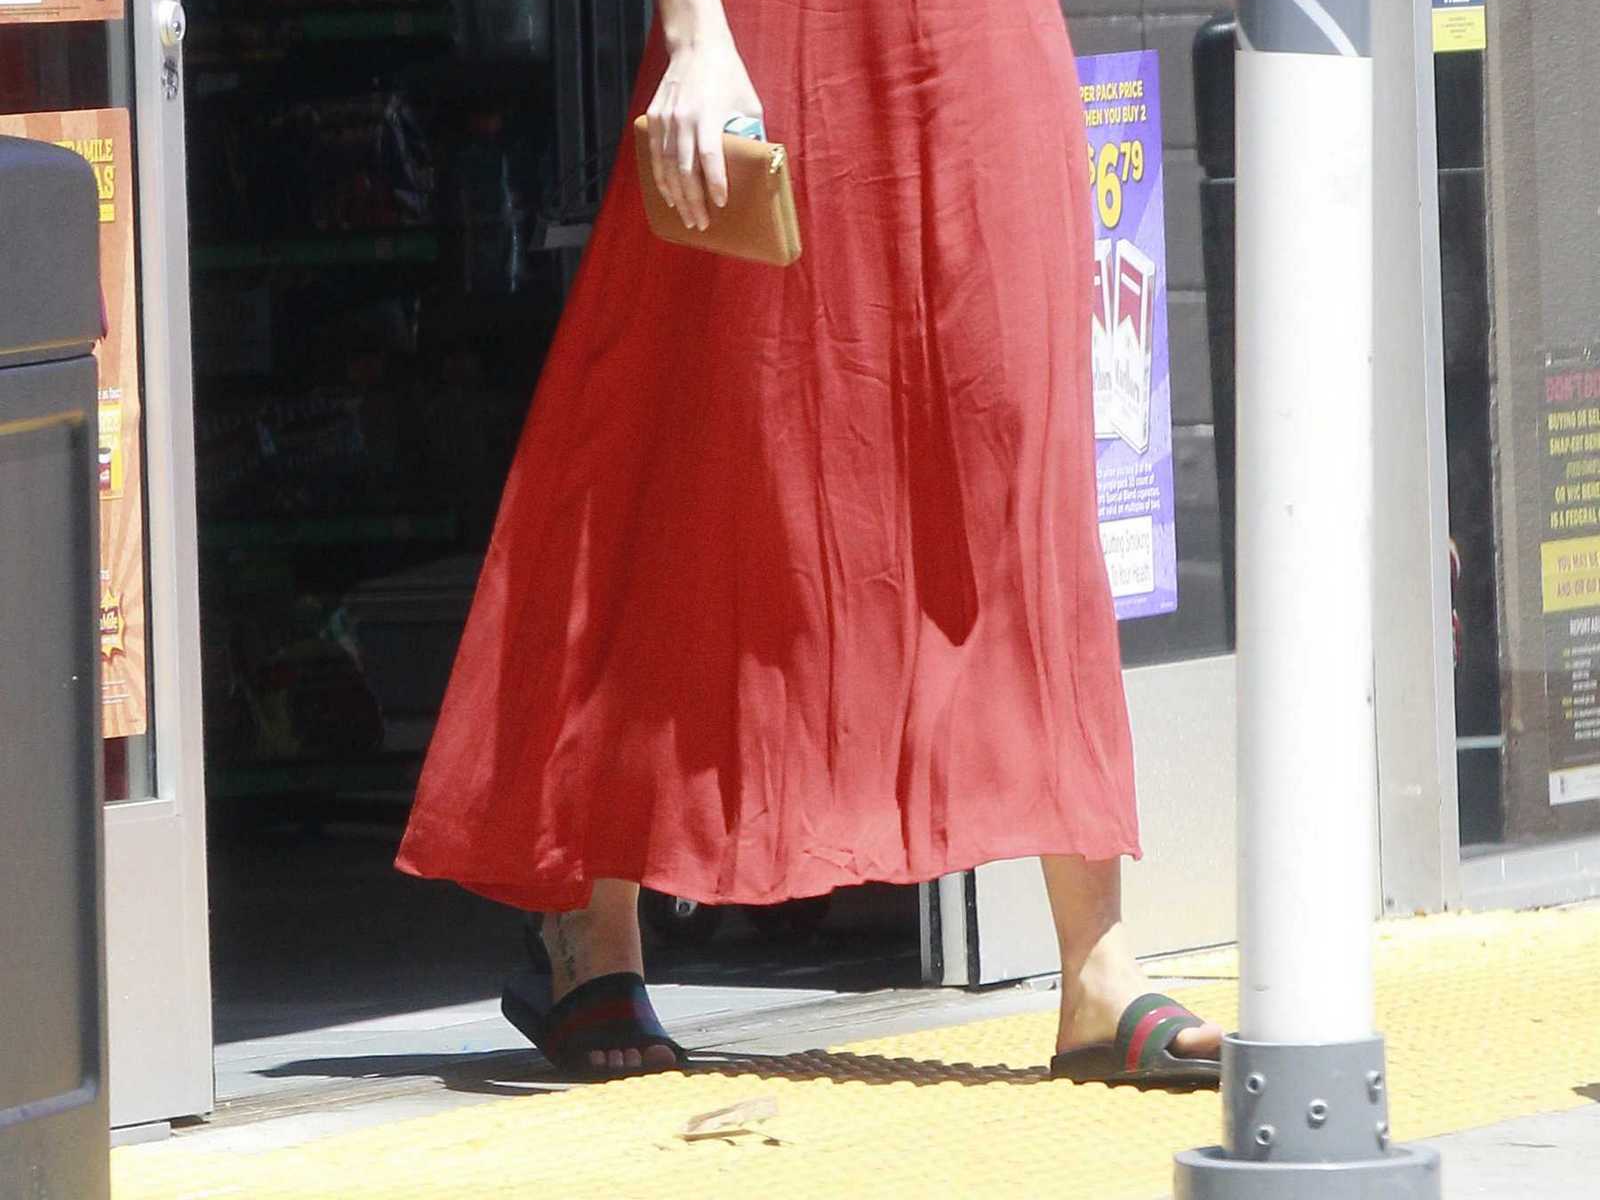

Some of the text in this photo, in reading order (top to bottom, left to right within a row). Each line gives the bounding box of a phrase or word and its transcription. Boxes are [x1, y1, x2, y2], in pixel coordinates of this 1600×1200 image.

[1080, 79, 1144, 102] PER PACK PRICE
[1083, 103, 1146, 128] HEN YOU BUY 2
[1565, 507, 1597, 528] FEDERAL
